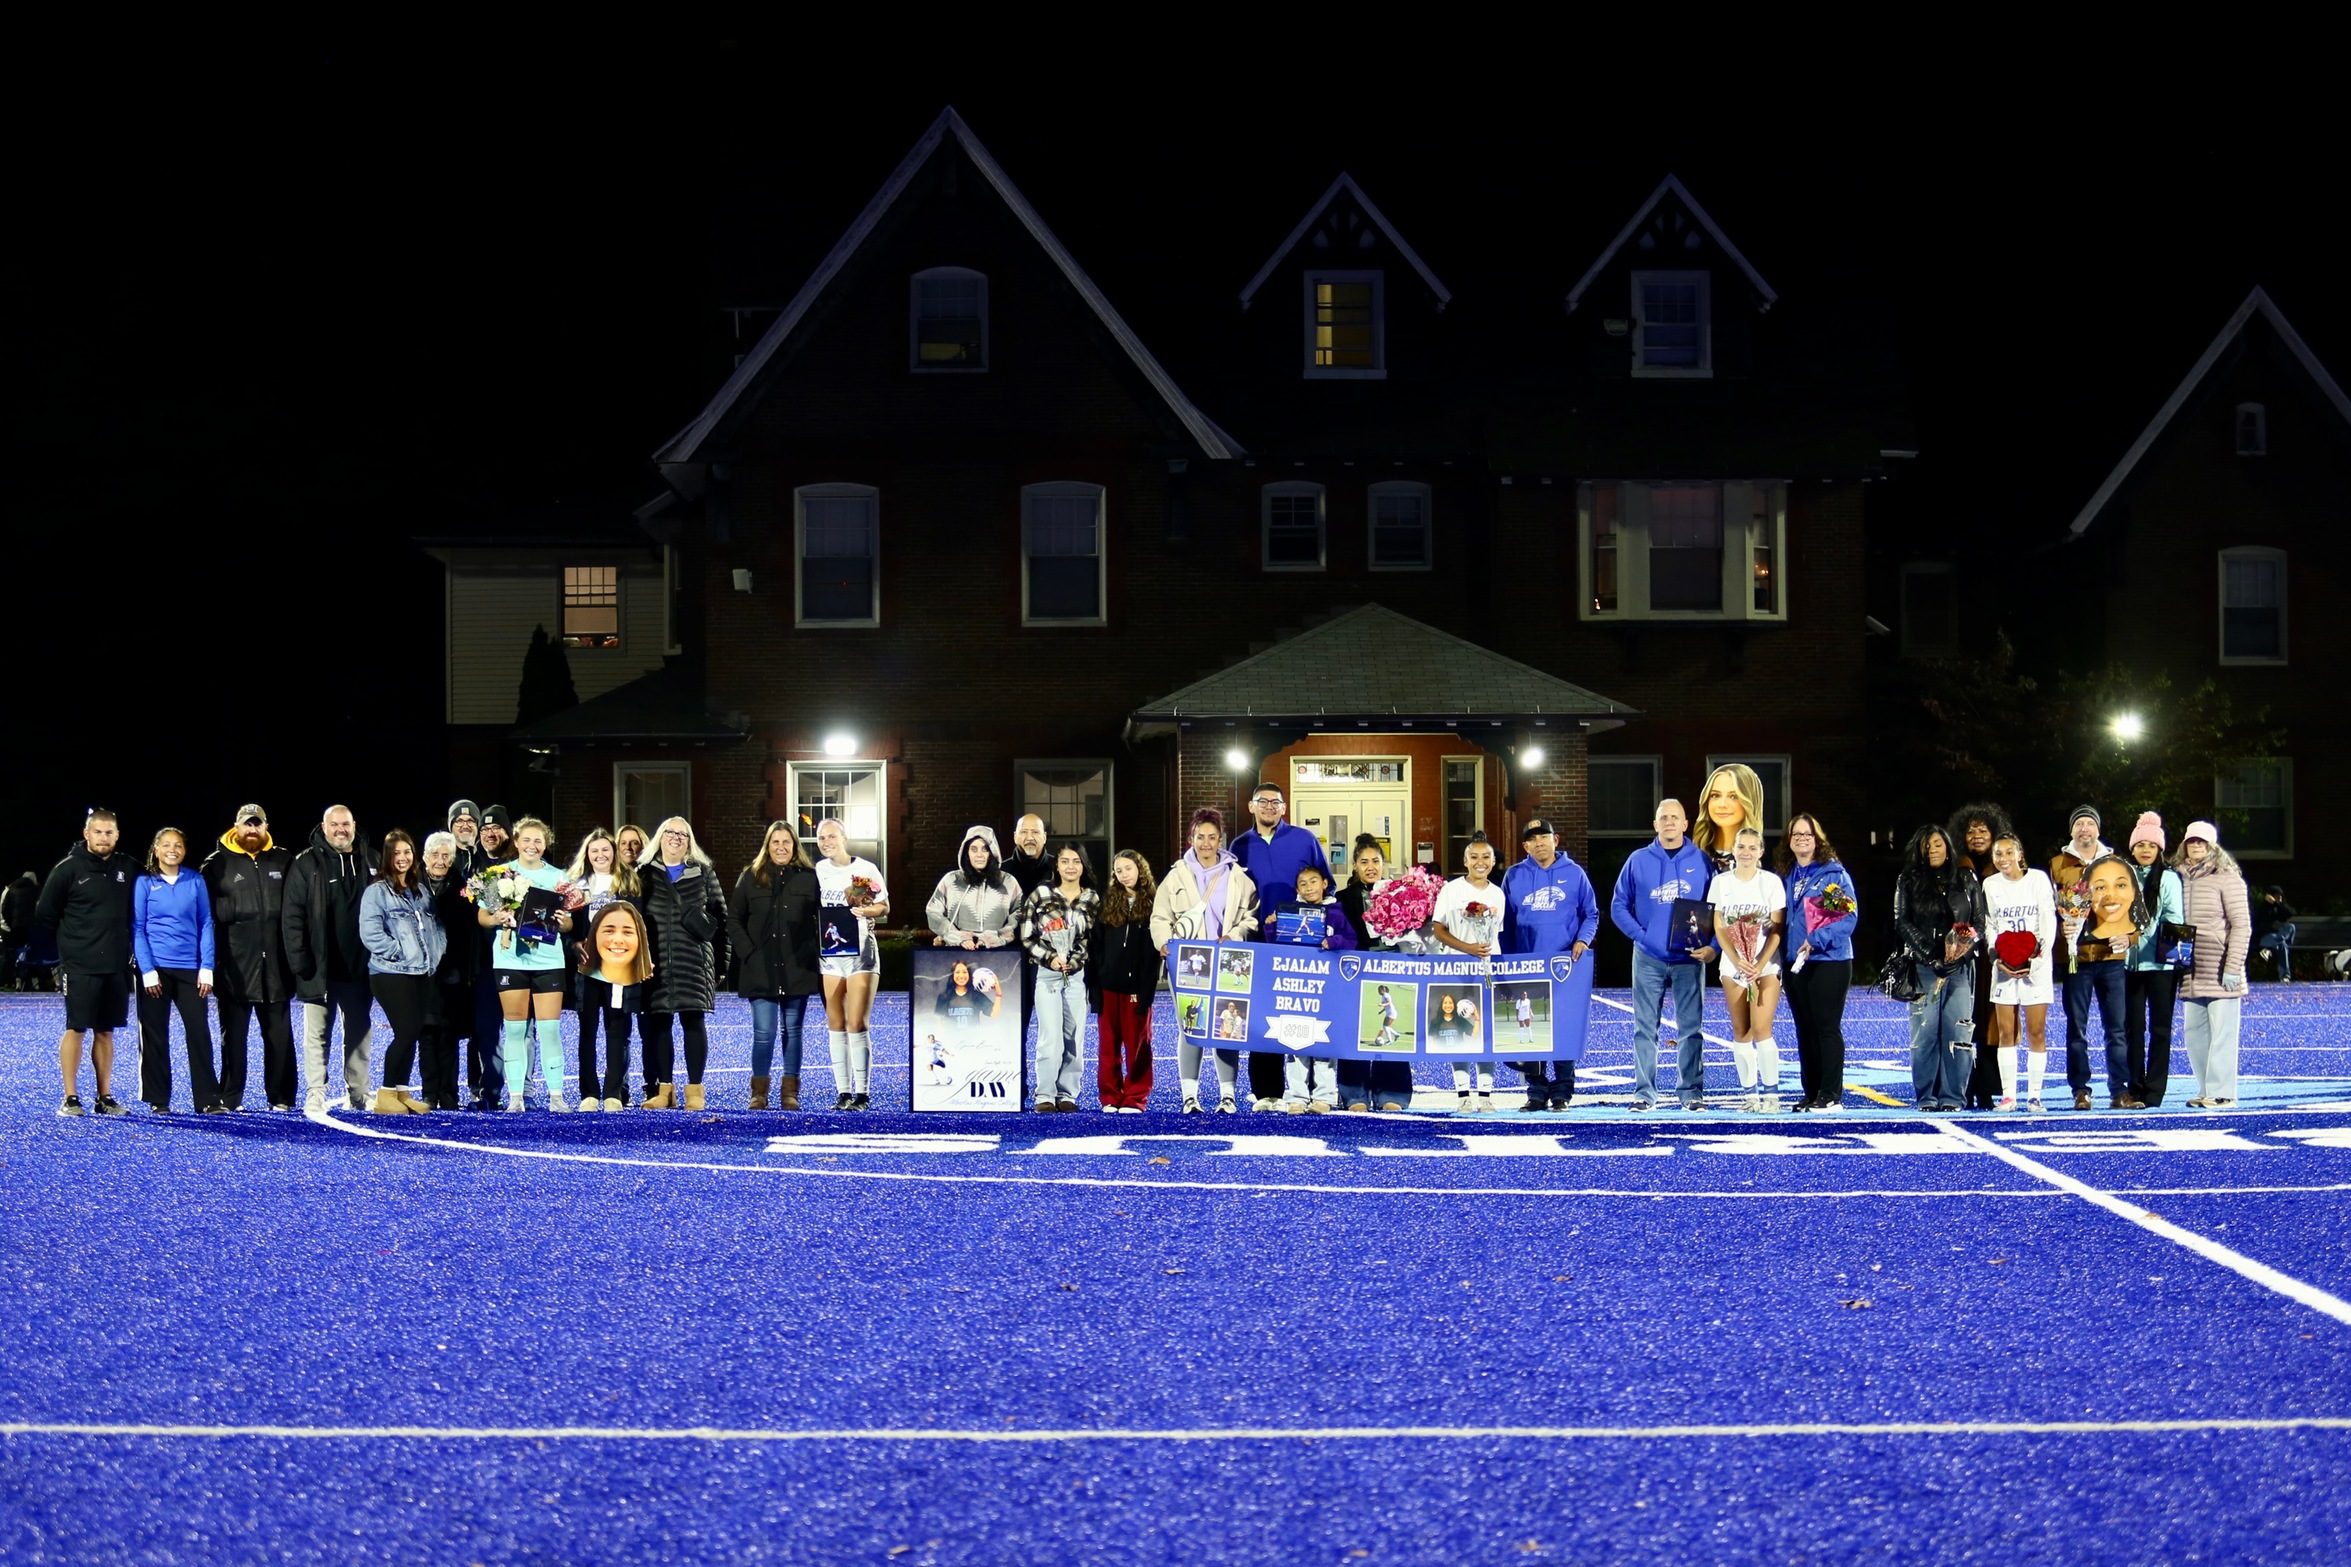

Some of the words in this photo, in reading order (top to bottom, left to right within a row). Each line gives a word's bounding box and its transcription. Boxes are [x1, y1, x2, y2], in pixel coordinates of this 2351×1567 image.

[1272, 956, 1330, 975] EJALAM
[1363, 959, 1432, 976] ALBERTUS
[1433, 961, 1485, 976] MAGNUS
[1490, 959, 1545, 976] COLLEGE
[1272, 977, 1326, 994] ASHLEY
[1275, 995, 1321, 1013] BRAVO
[1283, 1023, 1310, 1038] #10
[970, 1081, 1006, 1098] DAY
